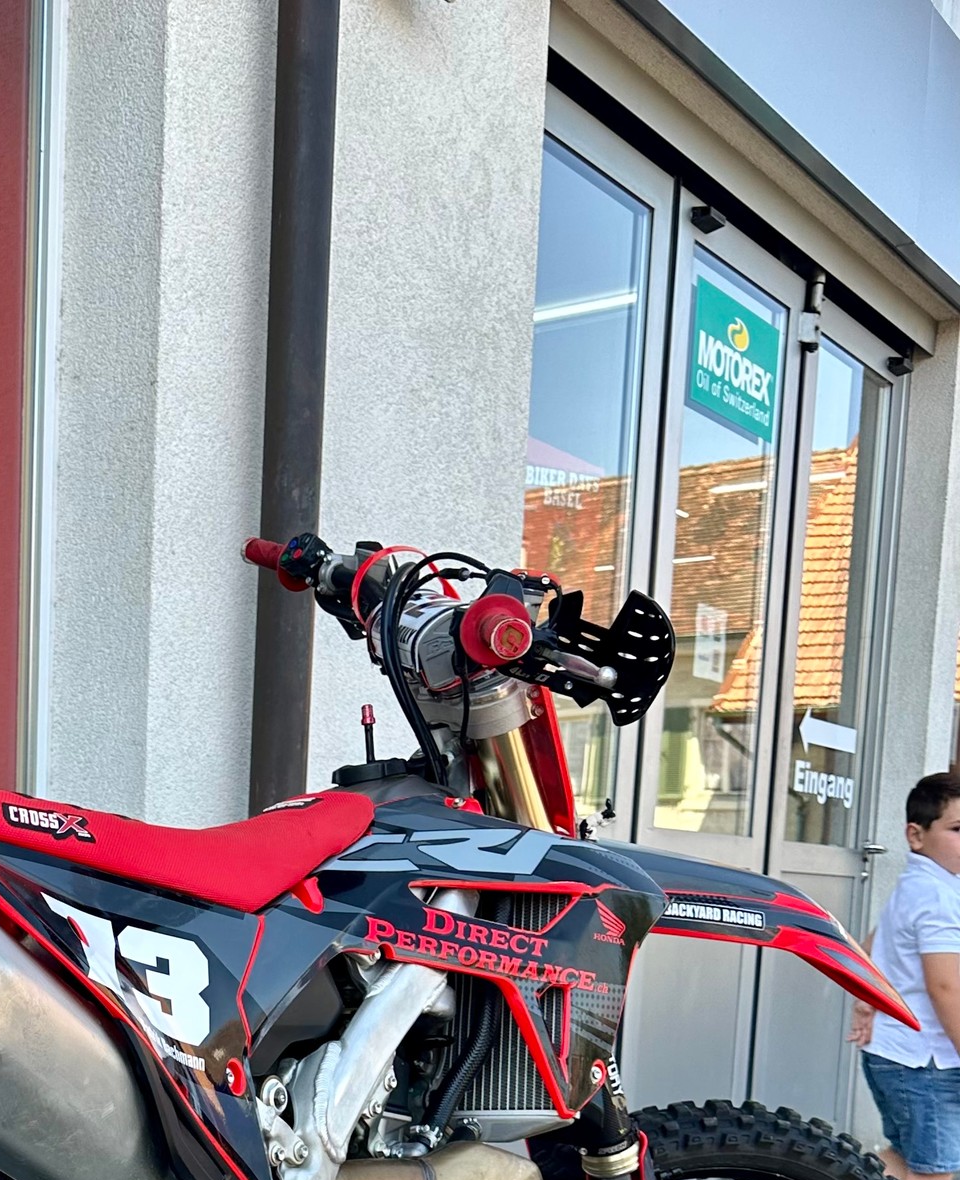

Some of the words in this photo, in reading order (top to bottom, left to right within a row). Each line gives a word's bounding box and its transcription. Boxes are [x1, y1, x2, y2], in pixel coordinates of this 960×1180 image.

[697, 329, 773, 406] MOTOREX
[696, 368, 710, 392] Oil
[711, 380, 723, 398] of
[723, 385, 770, 427] Switzerland
[525, 465, 566, 487] BIKER
[793, 759, 855, 809] Eingang
[422, 906, 549, 957] DIRECT
[593, 932, 626, 946] HONDA
[722, 908, 763, 928] RACING
